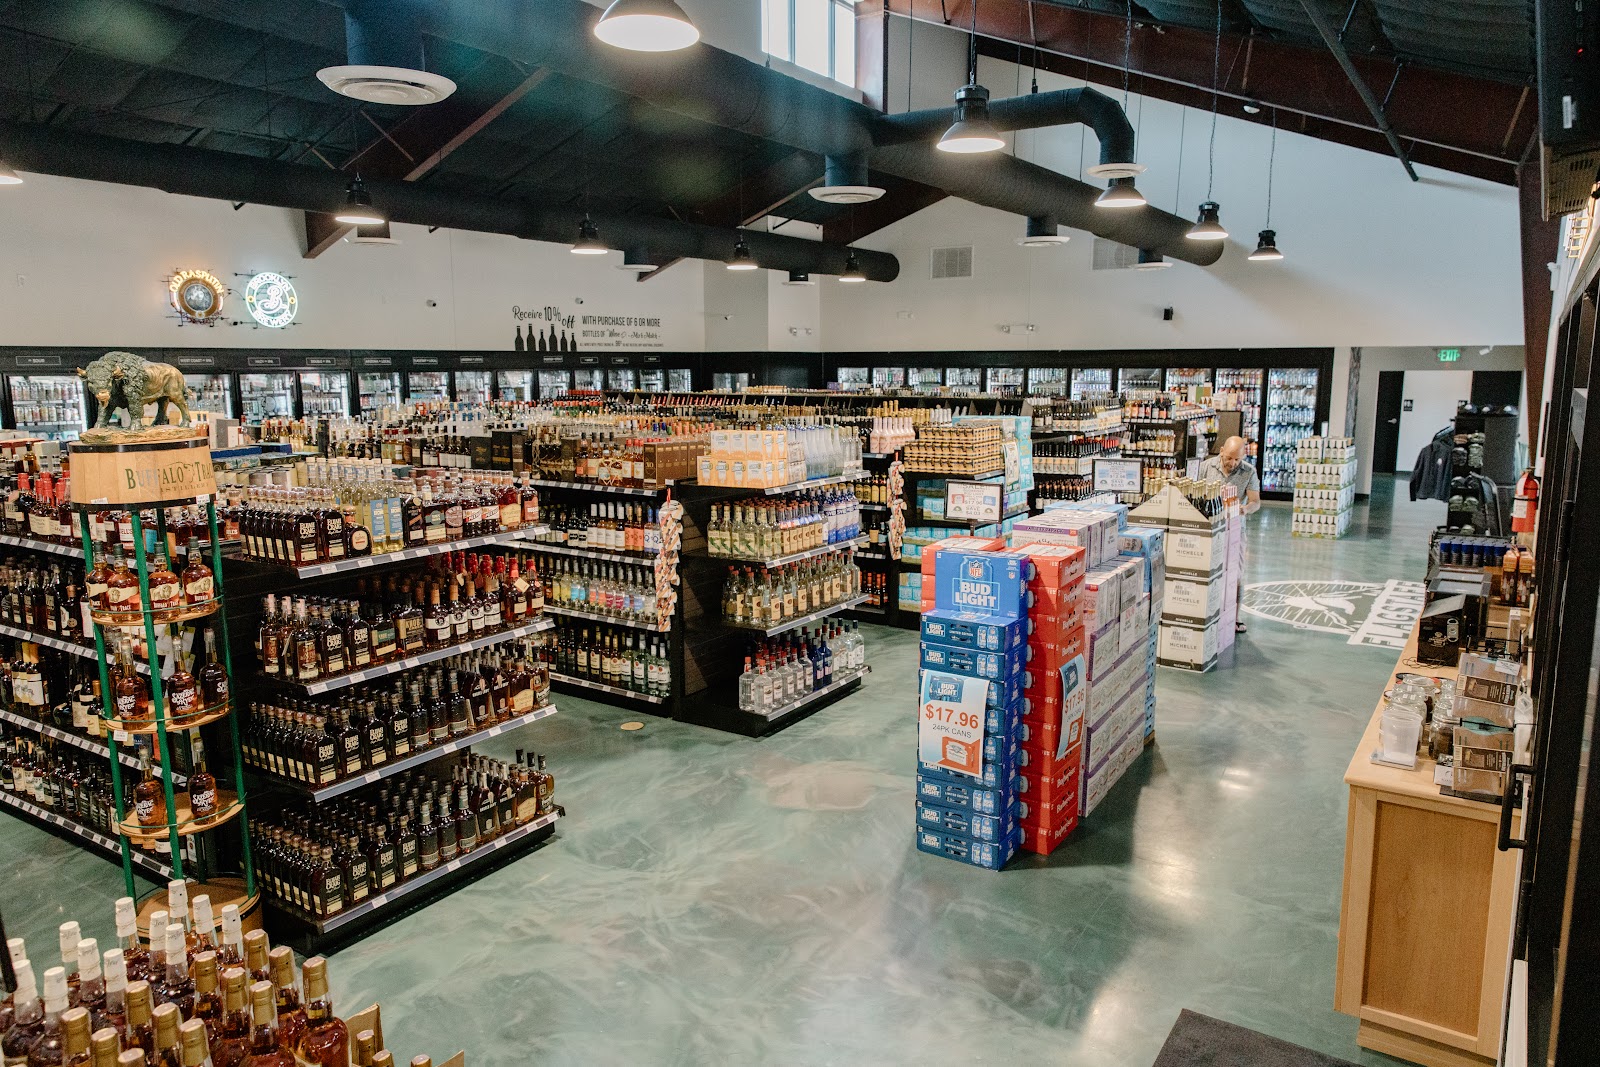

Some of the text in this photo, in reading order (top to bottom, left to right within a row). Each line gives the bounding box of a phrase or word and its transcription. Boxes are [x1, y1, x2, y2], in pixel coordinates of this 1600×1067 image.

[169, 269, 225, 294] OLD RASPUTIN
[250, 273, 291, 292] BROOKLYN
[252, 308, 294, 327] BREWERY
[512, 305, 576, 329] Receive 10% off
[581, 315, 661, 327] WITH PURCHASE OF 6 OR MORE
[582, 330, 600, 338] BOTTLES
[600, 330, 606, 338] OF
[1440, 349, 1458, 362] EXIT
[1176, 549, 1204, 557] MICHELLE
[969, 568, 983, 577] NFL
[960, 581, 992, 596] BUD
[955, 591, 997, 608] LIGHT
[1172, 596, 1200, 604] MICHELLE
[1361, 582, 1426, 648] FLAGSTAFF
[926, 628, 945, 637] LIGHT
[928, 623, 943, 631] BUD
[1169, 642, 1198, 650] MICHELLE
[926, 655, 944, 664] LIGHT
[937, 688, 958, 696] LIGHT
[1065, 688, 1084, 715] $17.96
[925, 703, 979, 729] $17.96
[932, 723, 972, 739] 24PK CANS
[922, 788, 940, 796] LIGHT
[922, 813, 939, 822] LIGHT
